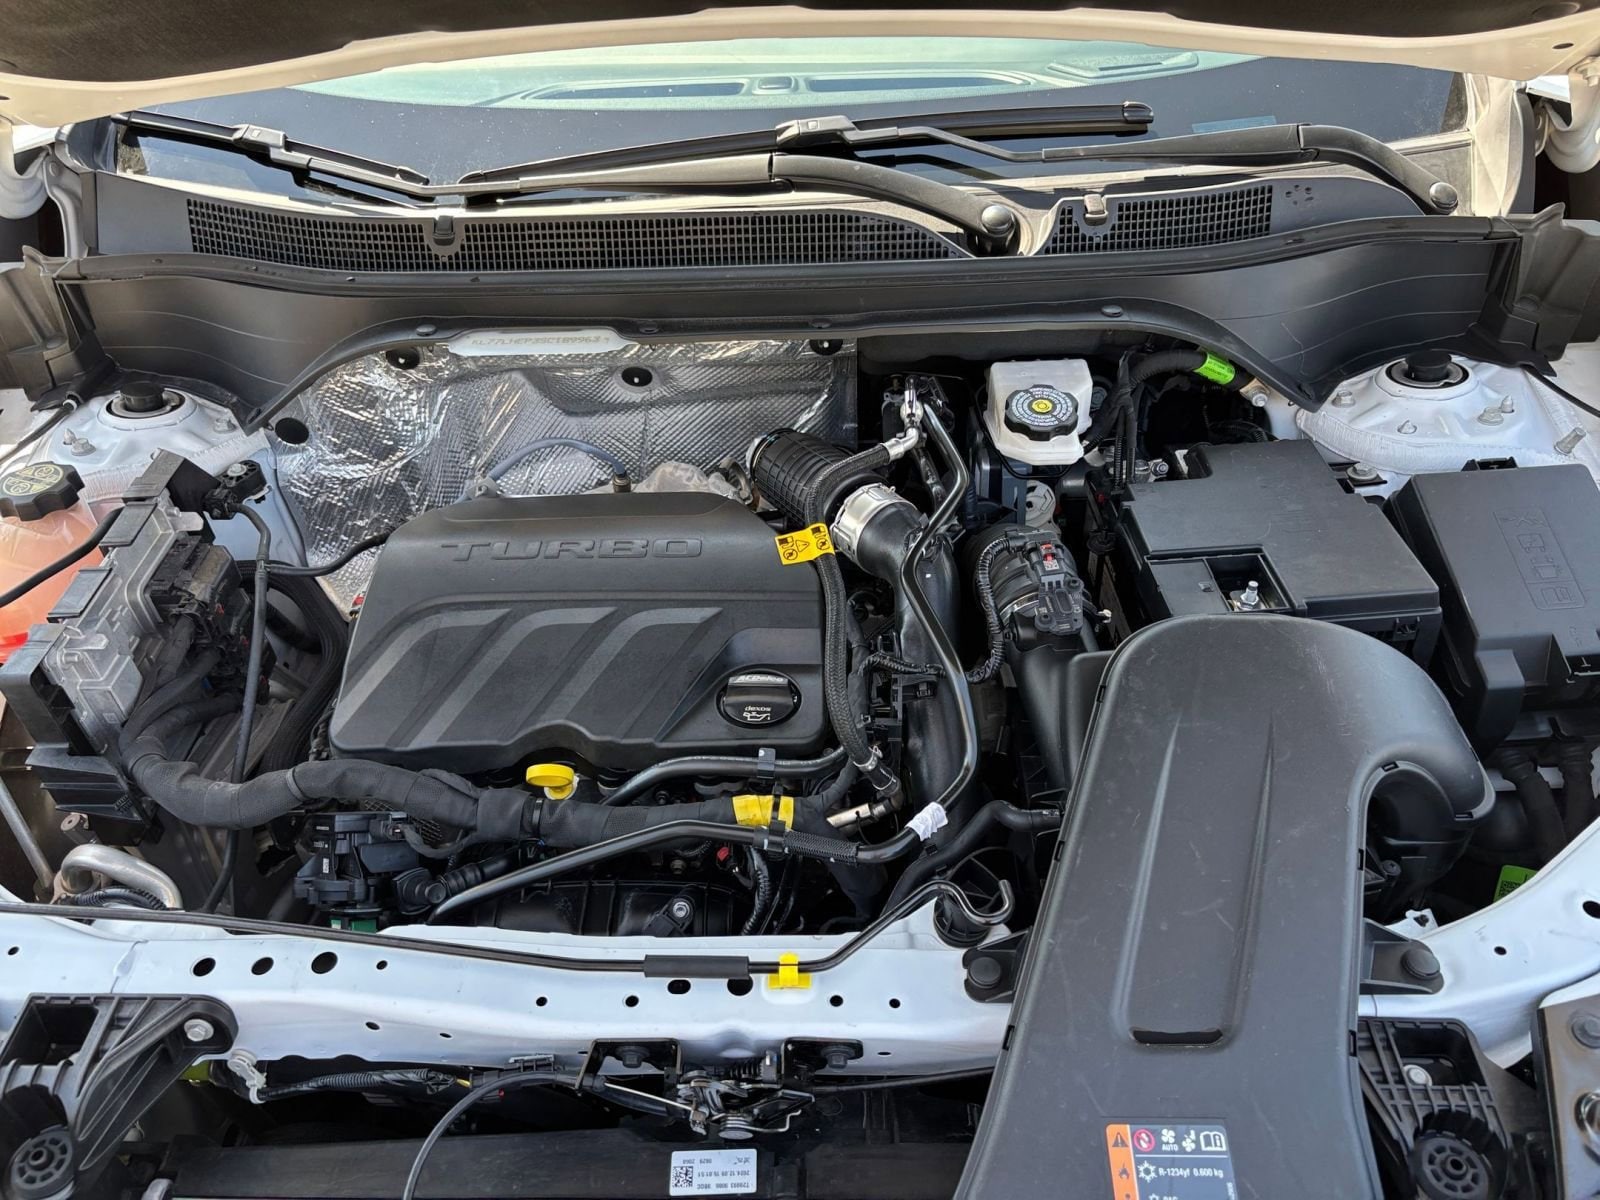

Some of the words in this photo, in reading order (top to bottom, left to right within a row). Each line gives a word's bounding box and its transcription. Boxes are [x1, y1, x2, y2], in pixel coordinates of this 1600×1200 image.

[441, 538, 703, 562] TURBO
[1161, 1143, 1179, 1152] AUTO
[1158, 1167, 1190, 1179] R-1234yf
[1192, 1167, 1213, 1177] 0.600
[1213, 1167, 1224, 1179] kg
